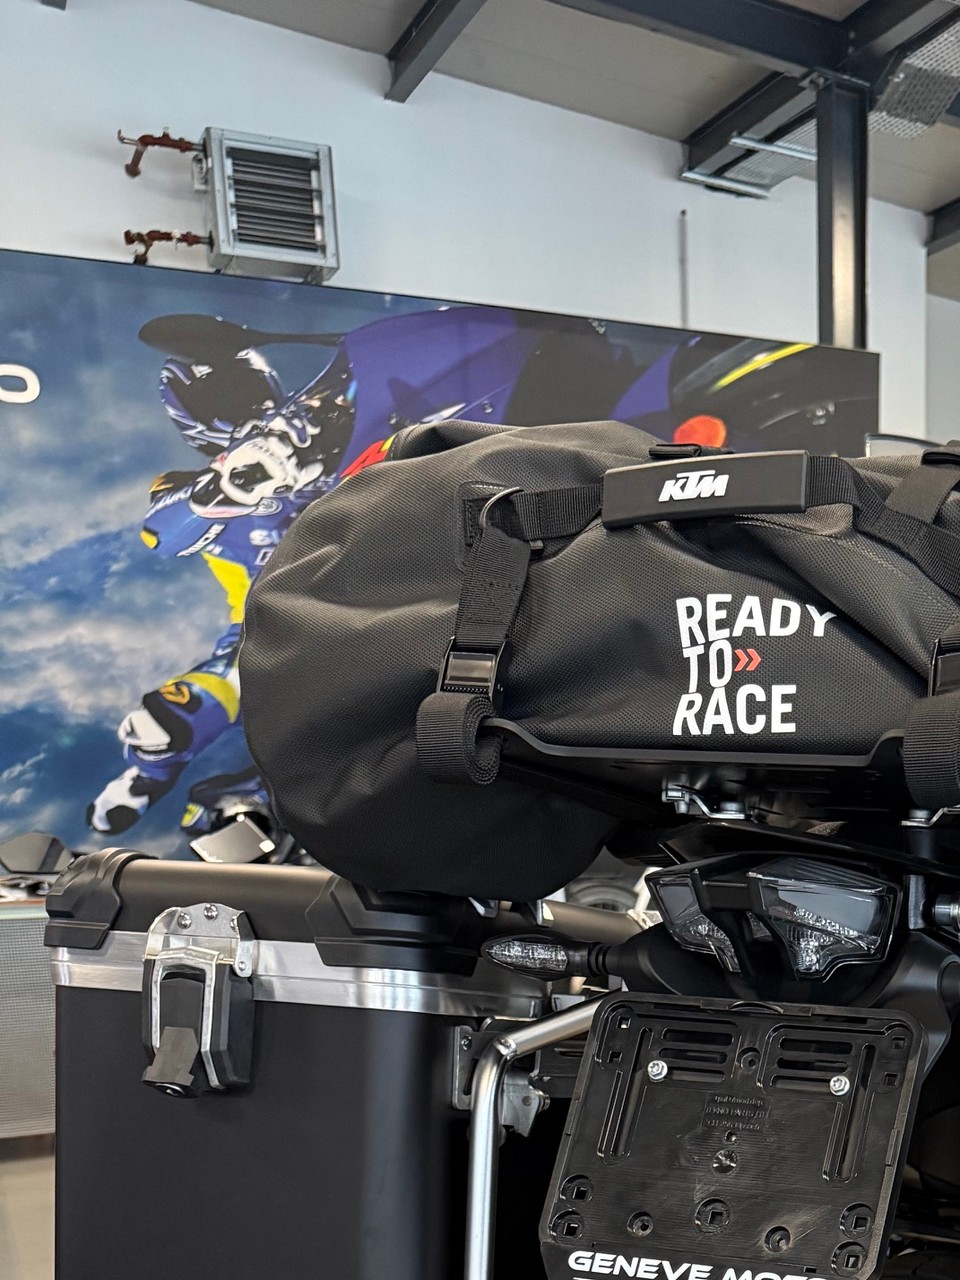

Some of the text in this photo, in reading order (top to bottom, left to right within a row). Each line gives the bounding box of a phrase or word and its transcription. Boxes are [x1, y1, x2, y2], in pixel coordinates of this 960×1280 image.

[658, 470, 730, 502] KTM
[676, 593, 837, 648] READY
[682, 639, 733, 694] TO
[672, 684, 797, 736] RACE
